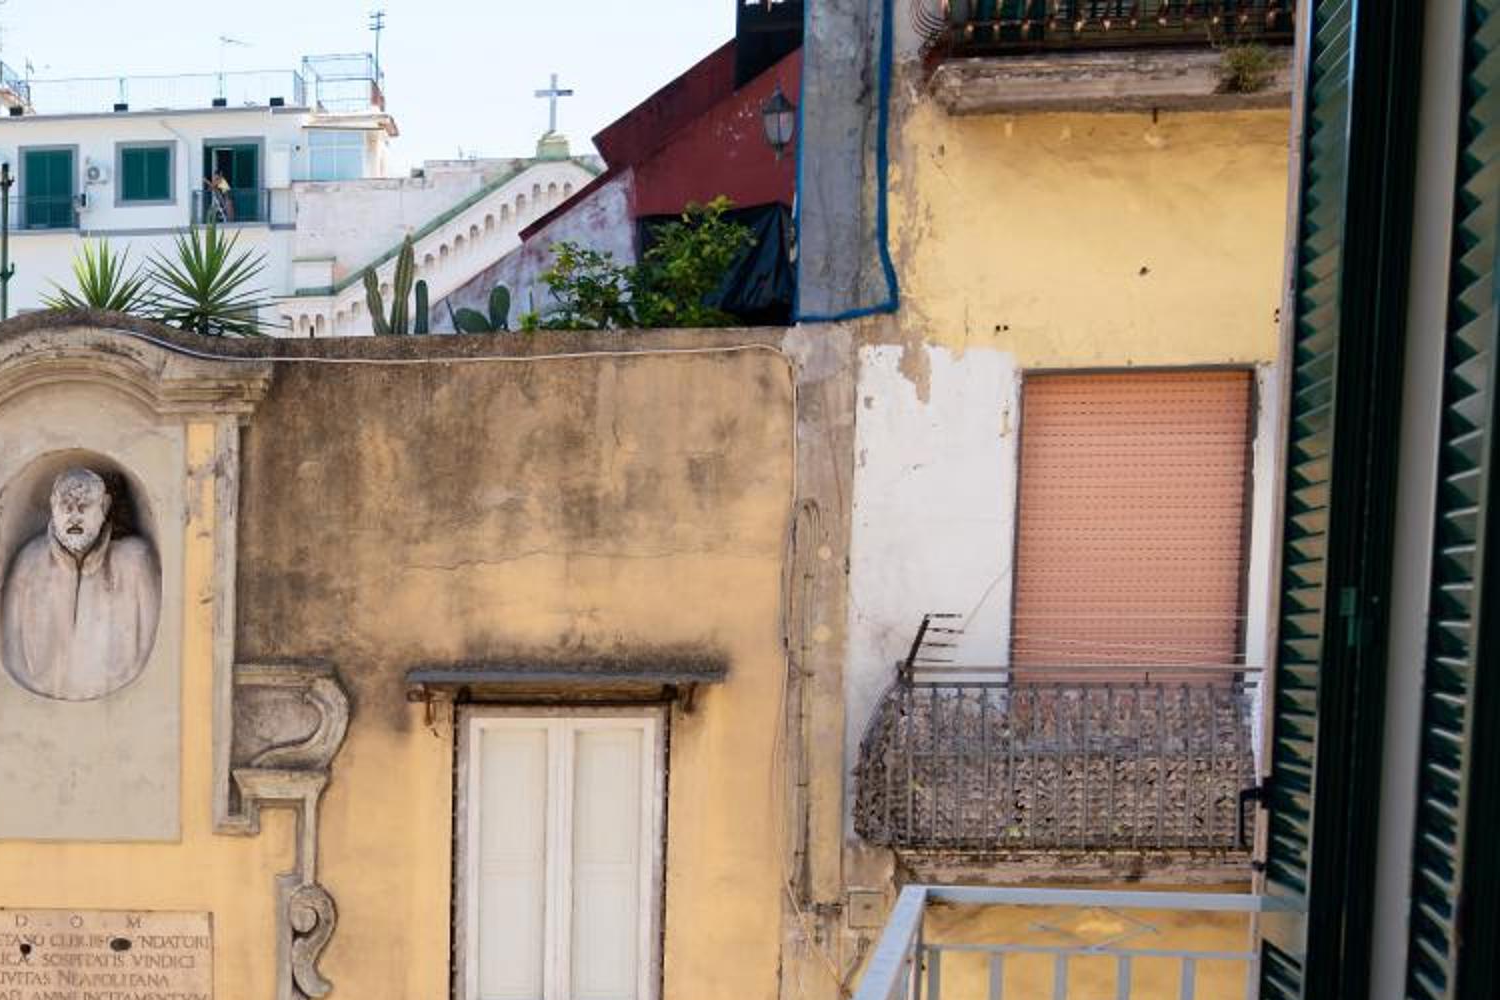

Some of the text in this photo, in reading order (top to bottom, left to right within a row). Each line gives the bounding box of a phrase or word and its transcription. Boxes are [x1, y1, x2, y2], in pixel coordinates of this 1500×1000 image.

[14, 914, 142, 929] D O M
[131, 954, 196, 969] VINDICI
[57, 969, 170, 988] NEAPOLITANA
